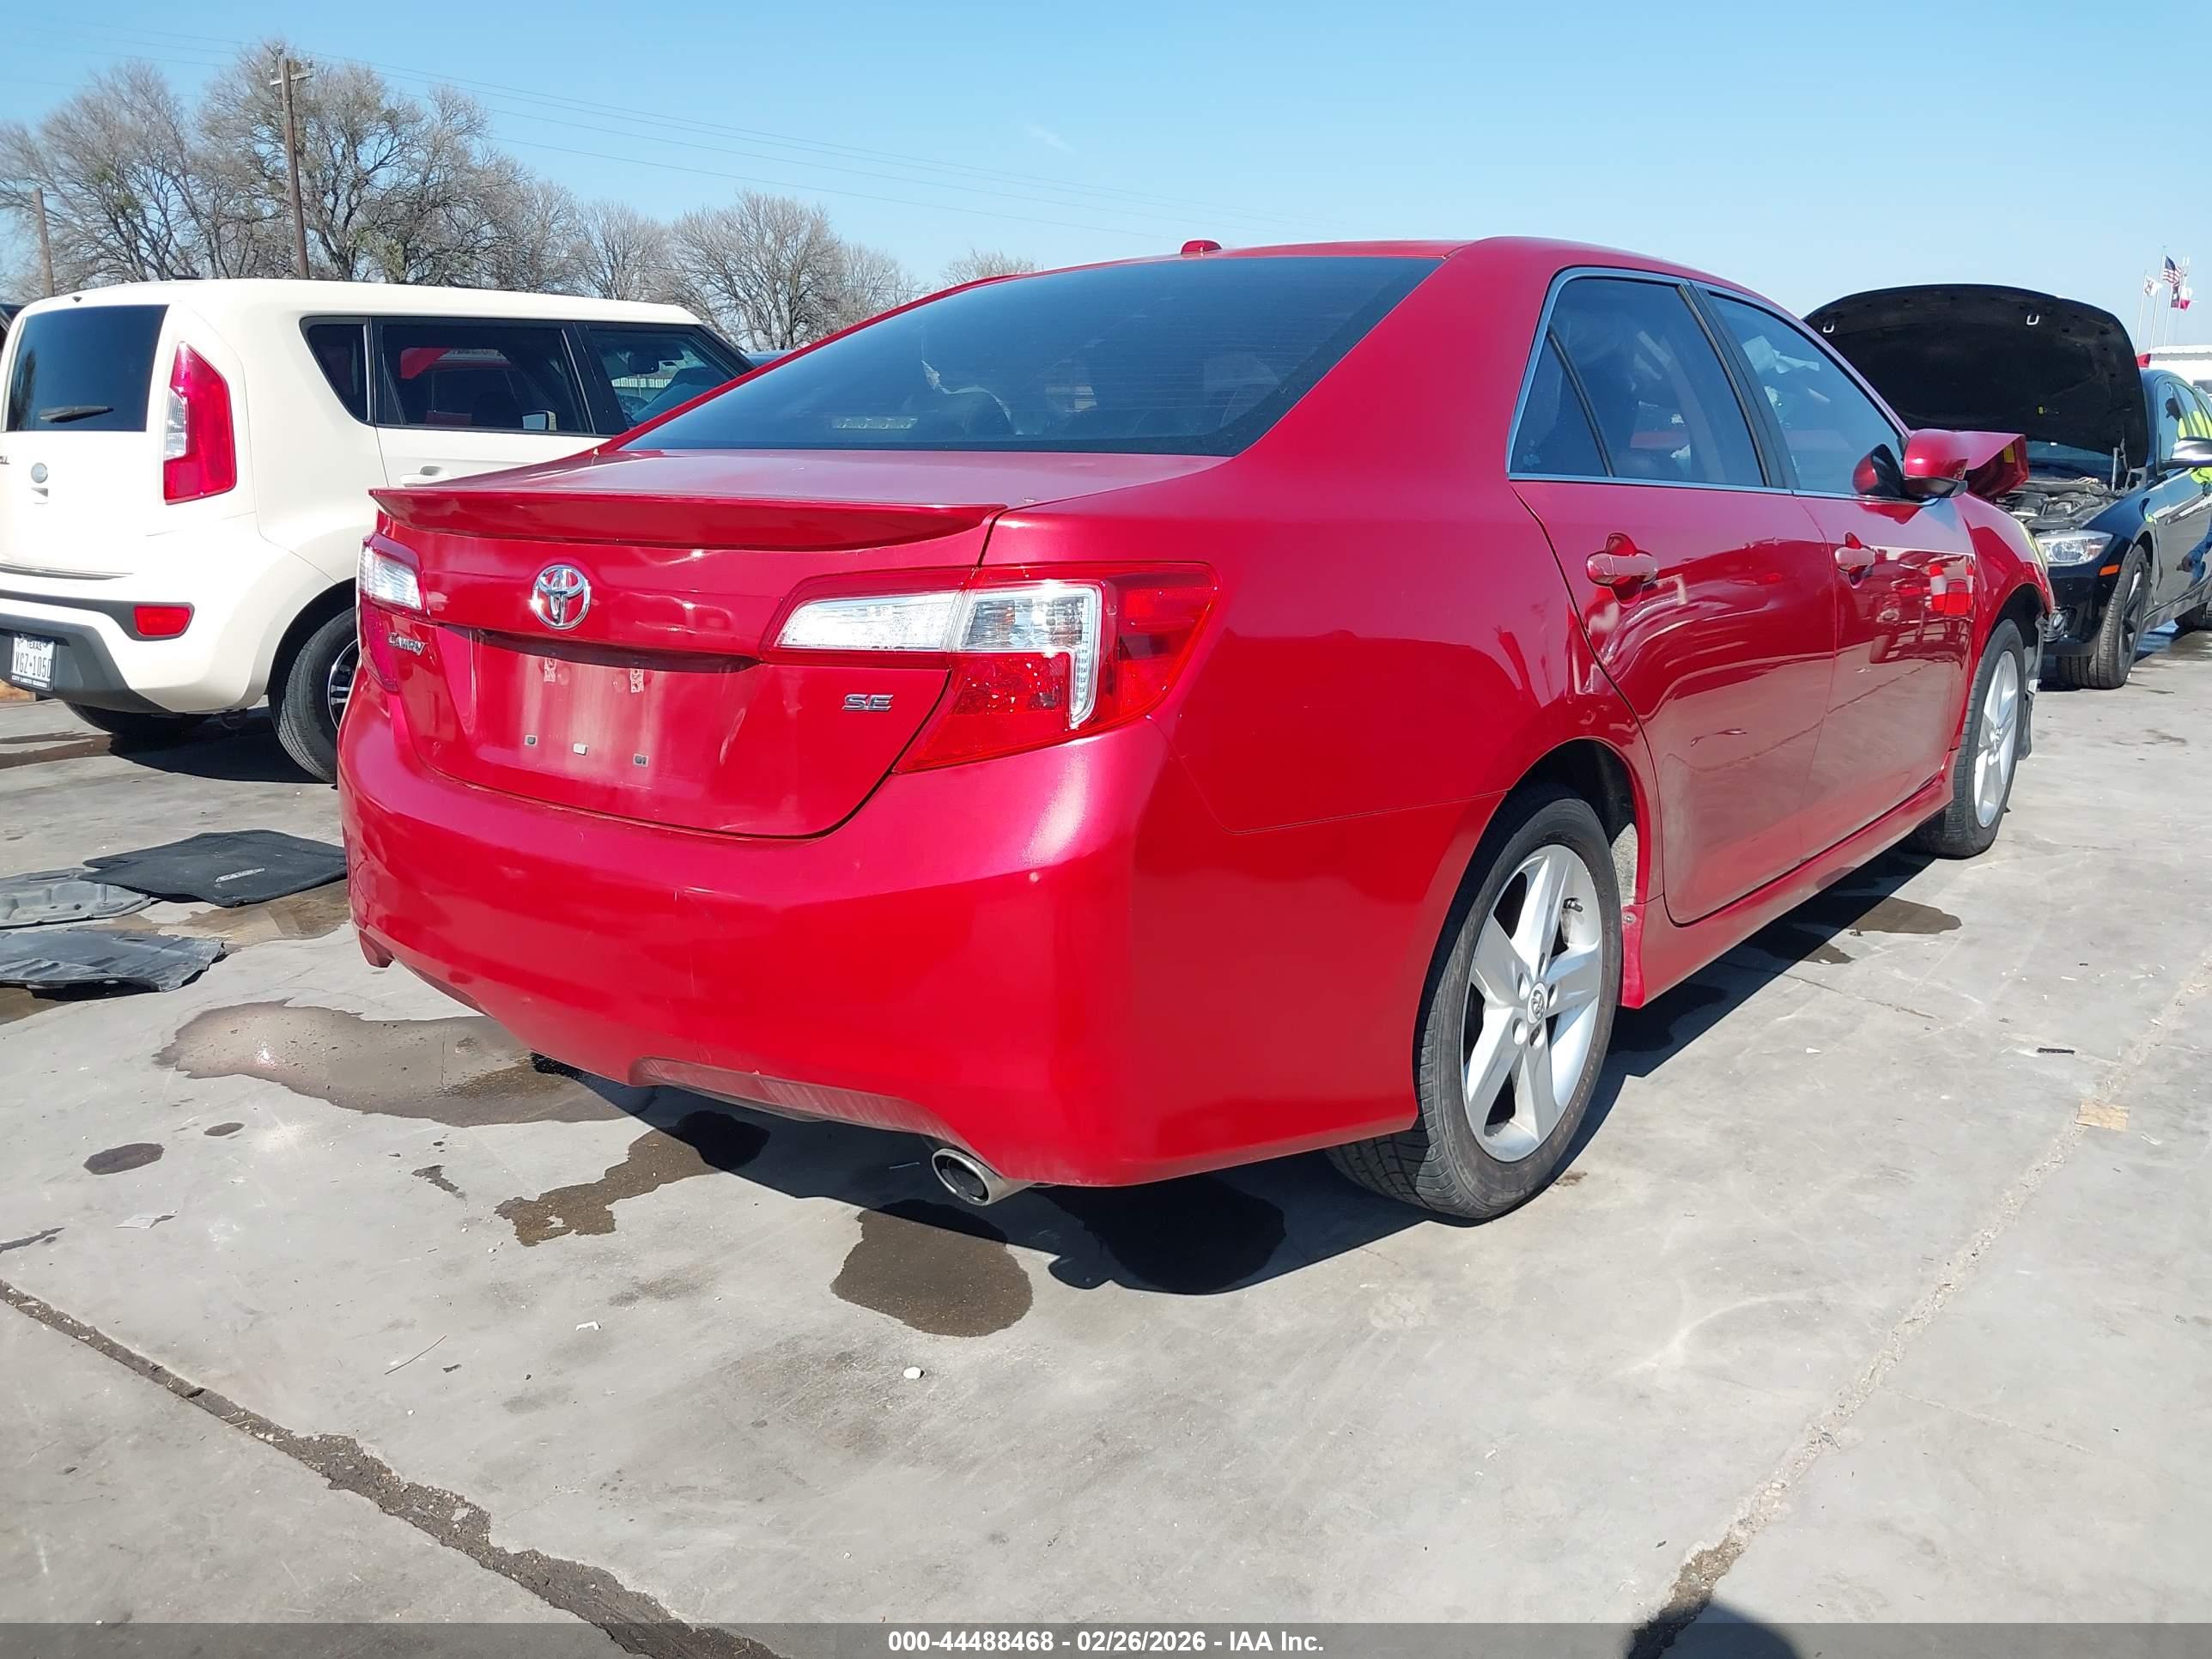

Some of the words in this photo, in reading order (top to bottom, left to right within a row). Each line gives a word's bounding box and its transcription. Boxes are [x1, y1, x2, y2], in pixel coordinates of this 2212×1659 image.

[27, 640, 42, 651] TEXAS
[388, 631, 428, 656] CAMRY
[842, 693, 894, 712] SE
